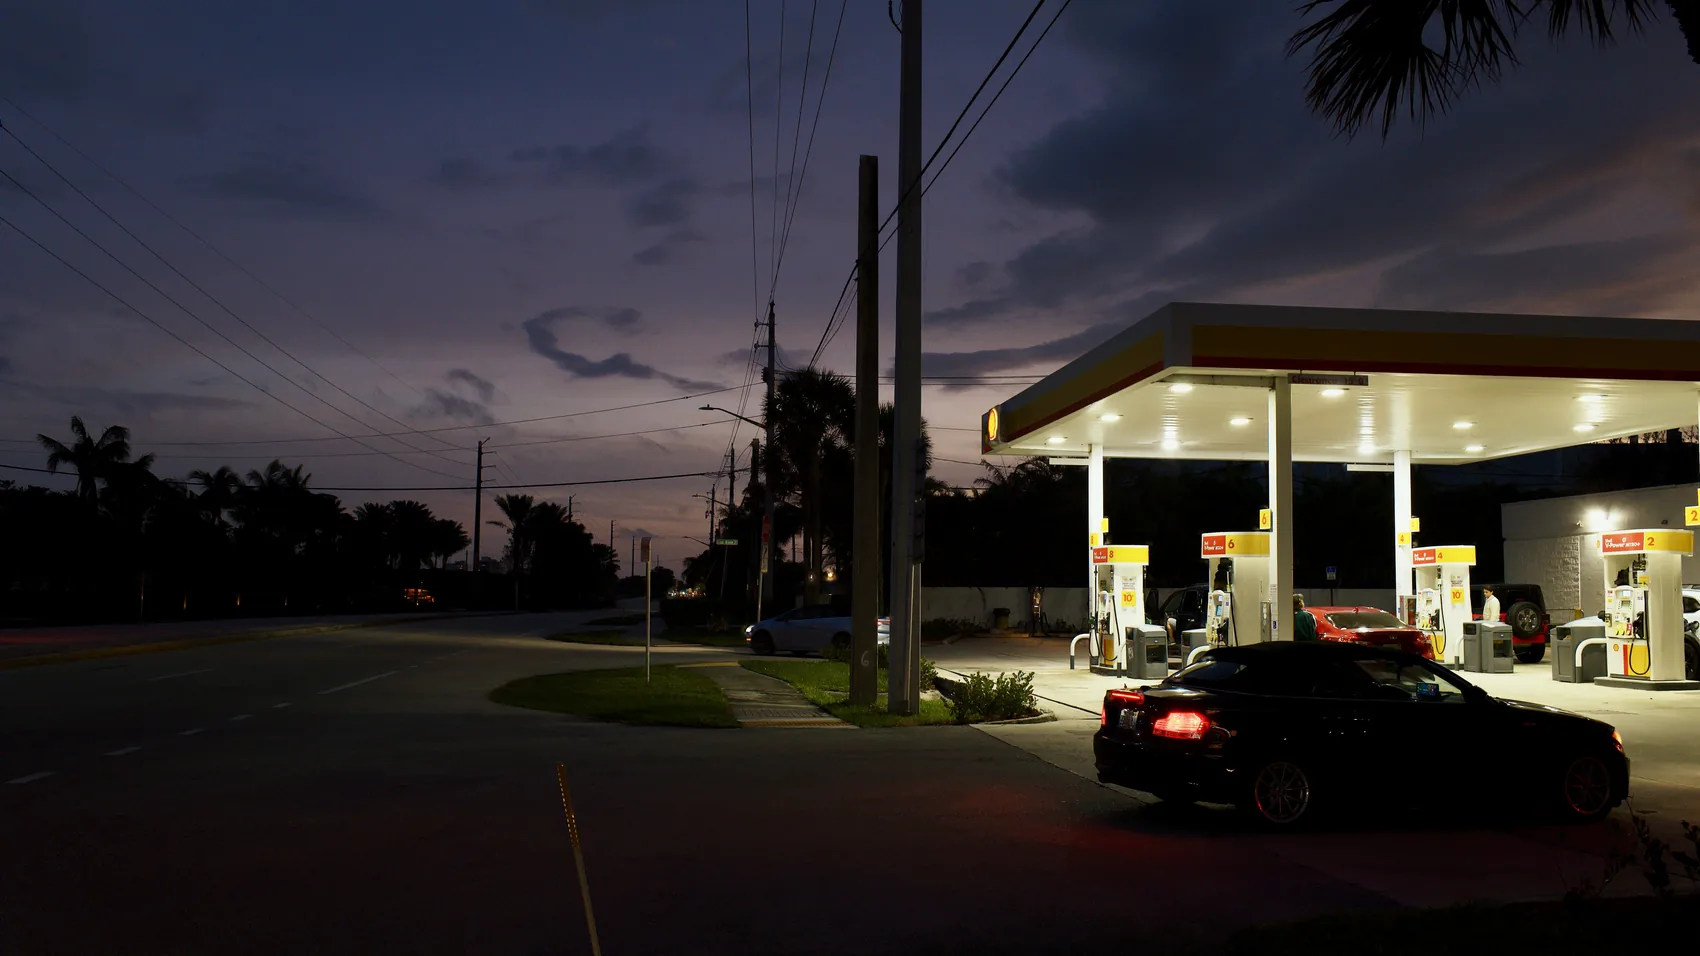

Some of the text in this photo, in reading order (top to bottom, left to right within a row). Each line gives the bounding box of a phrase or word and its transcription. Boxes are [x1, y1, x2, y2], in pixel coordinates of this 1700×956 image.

[1261, 513, 1267, 525] 6
[1691, 510, 1698, 521] 2
[1228, 539, 1235, 549] 6
[1647, 537, 1655, 546] 2
[1109, 550, 1114, 559] 8
[860, 650, 870, 667] 6
